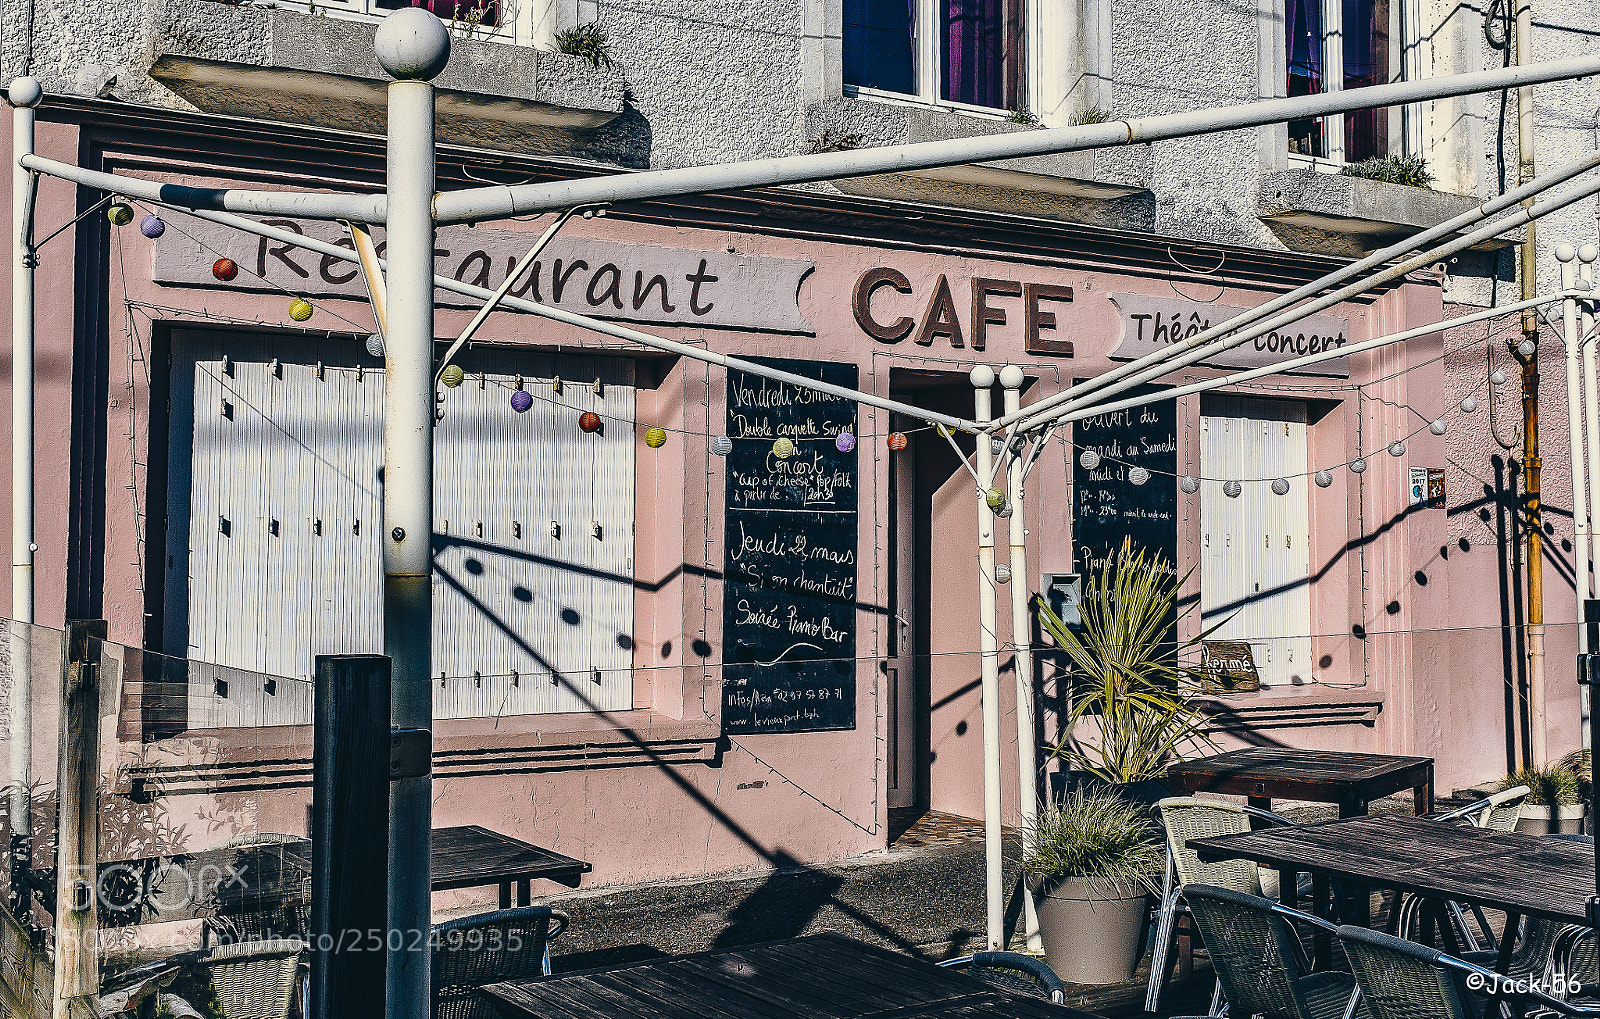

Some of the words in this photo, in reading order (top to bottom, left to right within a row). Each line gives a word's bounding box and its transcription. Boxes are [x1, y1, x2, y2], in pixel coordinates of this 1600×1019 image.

[851, 266, 1074, 357] CAFE
[1140, 406, 1159, 424] du
[731, 520, 786, 561] Jeudi
[822, 616, 849, 643] Bar
